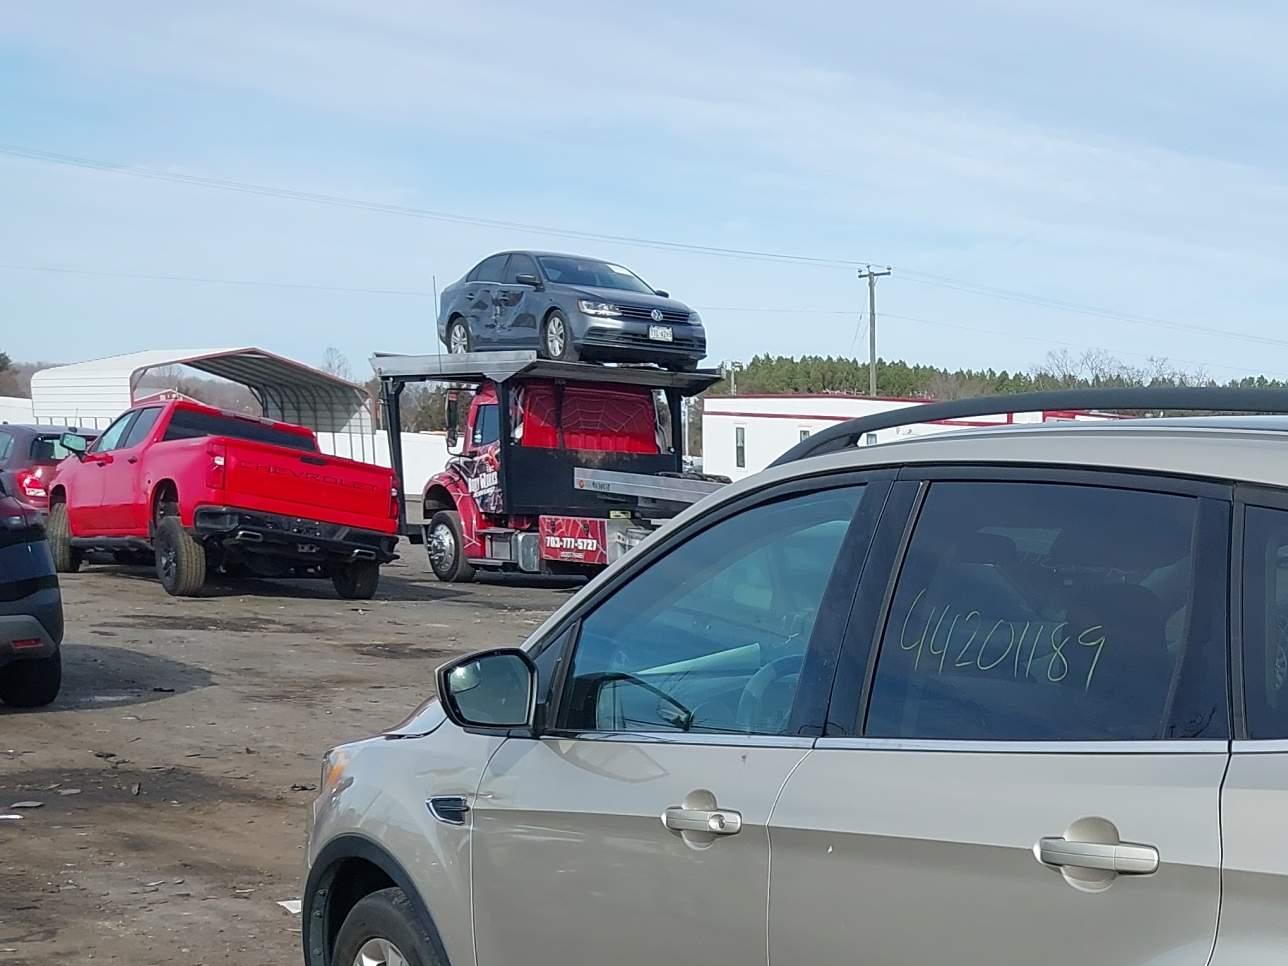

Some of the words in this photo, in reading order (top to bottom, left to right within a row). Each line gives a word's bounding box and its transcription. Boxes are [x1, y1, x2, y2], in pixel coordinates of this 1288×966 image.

[239, 461, 377, 491] CHEVROLET
[545, 535, 597, 551] 703-777-5727
[901, 588, 1106, 691] 44201189
